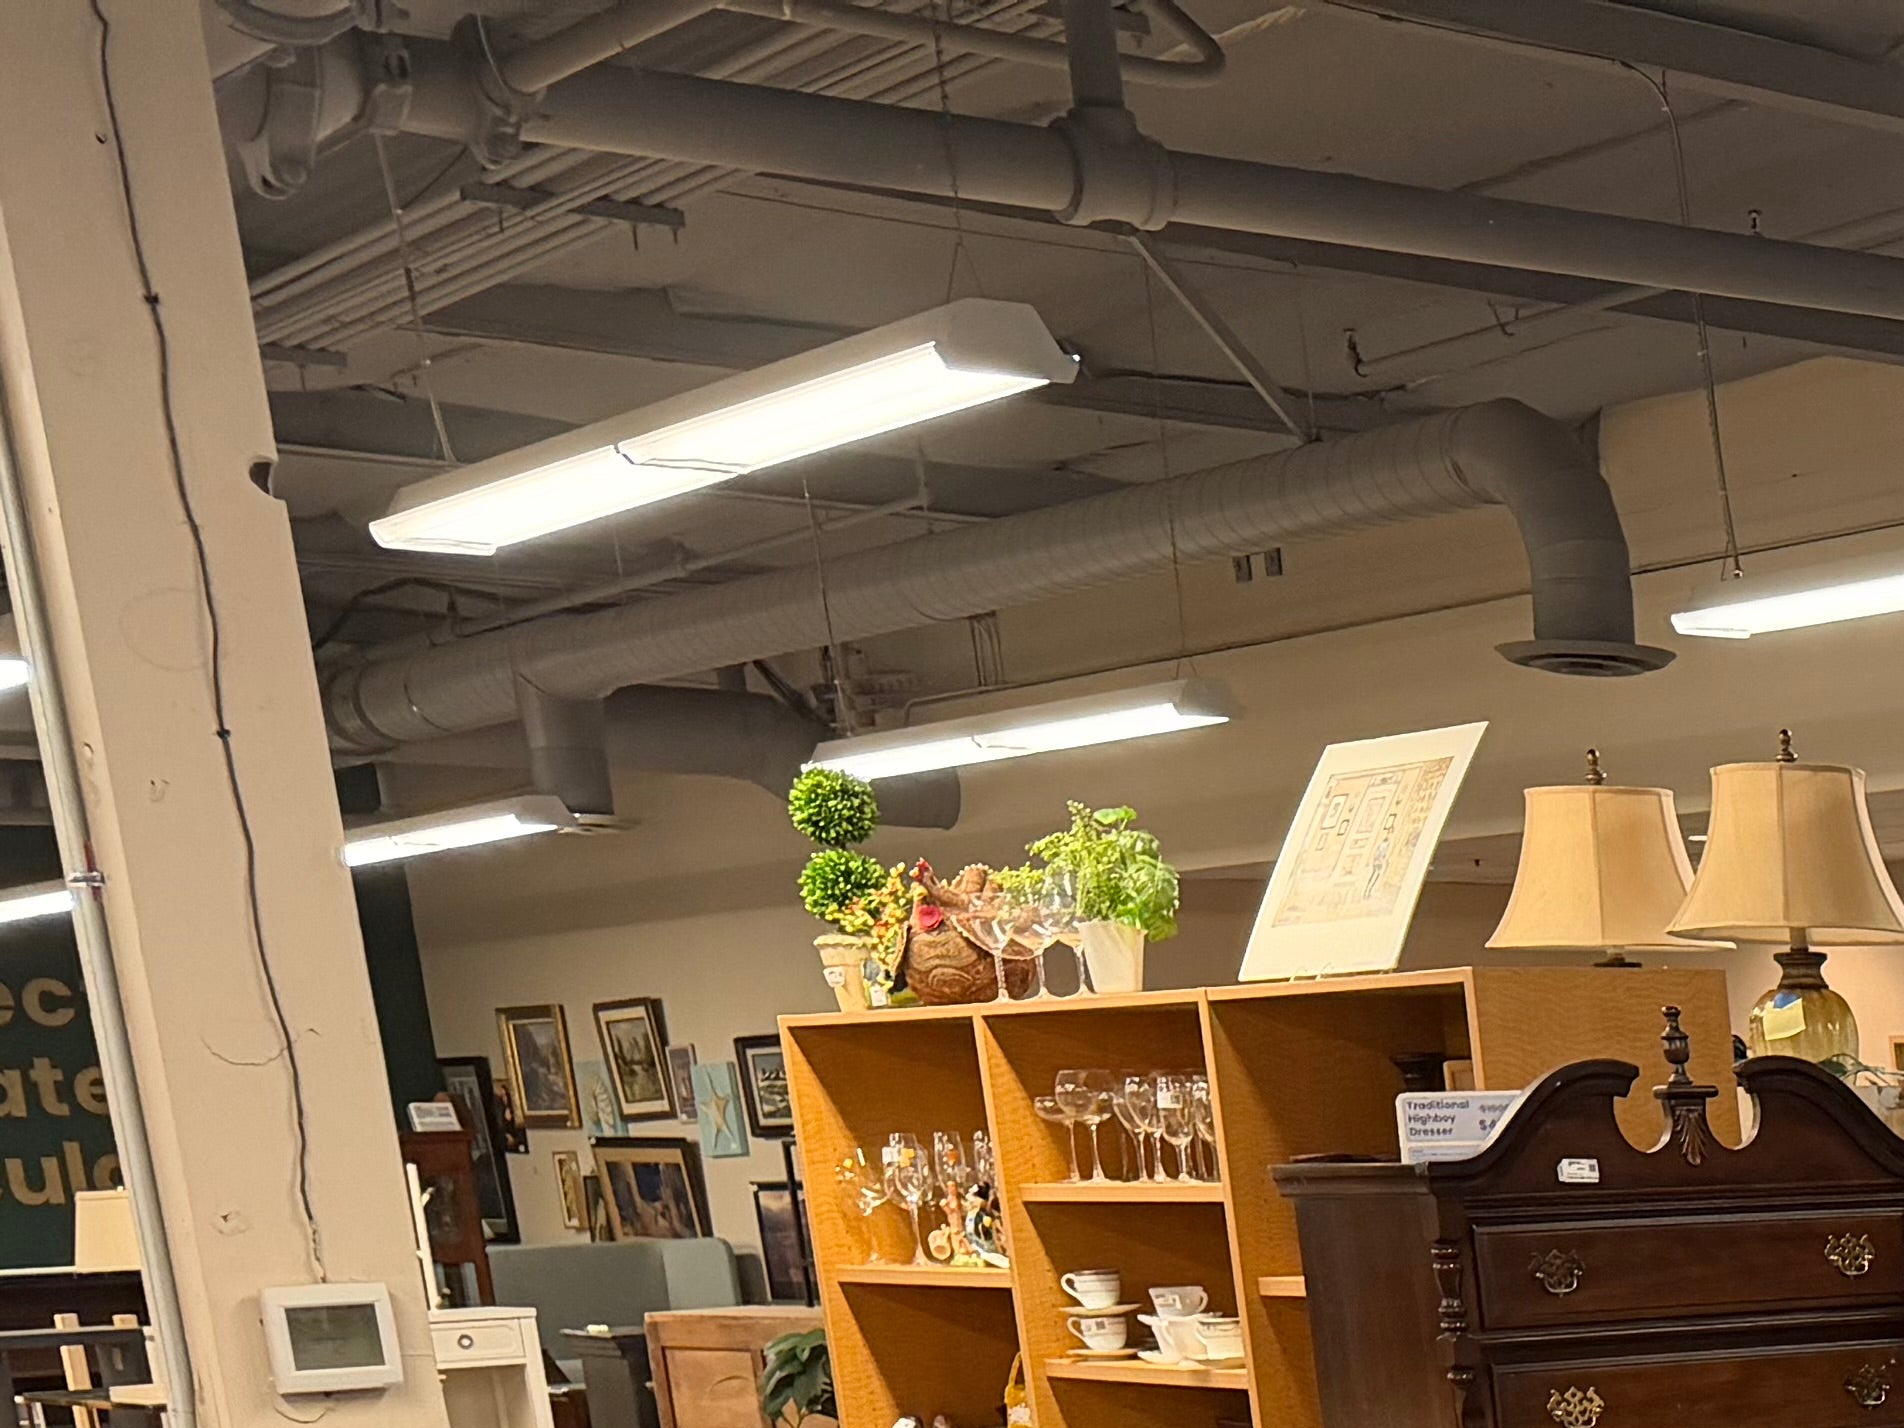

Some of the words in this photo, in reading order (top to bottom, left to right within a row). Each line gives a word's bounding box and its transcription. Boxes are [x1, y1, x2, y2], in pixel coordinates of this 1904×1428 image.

[1406, 1100, 1470, 1111] Traditional
[1408, 1113, 1456, 1126] Highboy
[1409, 1126, 1454, 1137] Dresser
